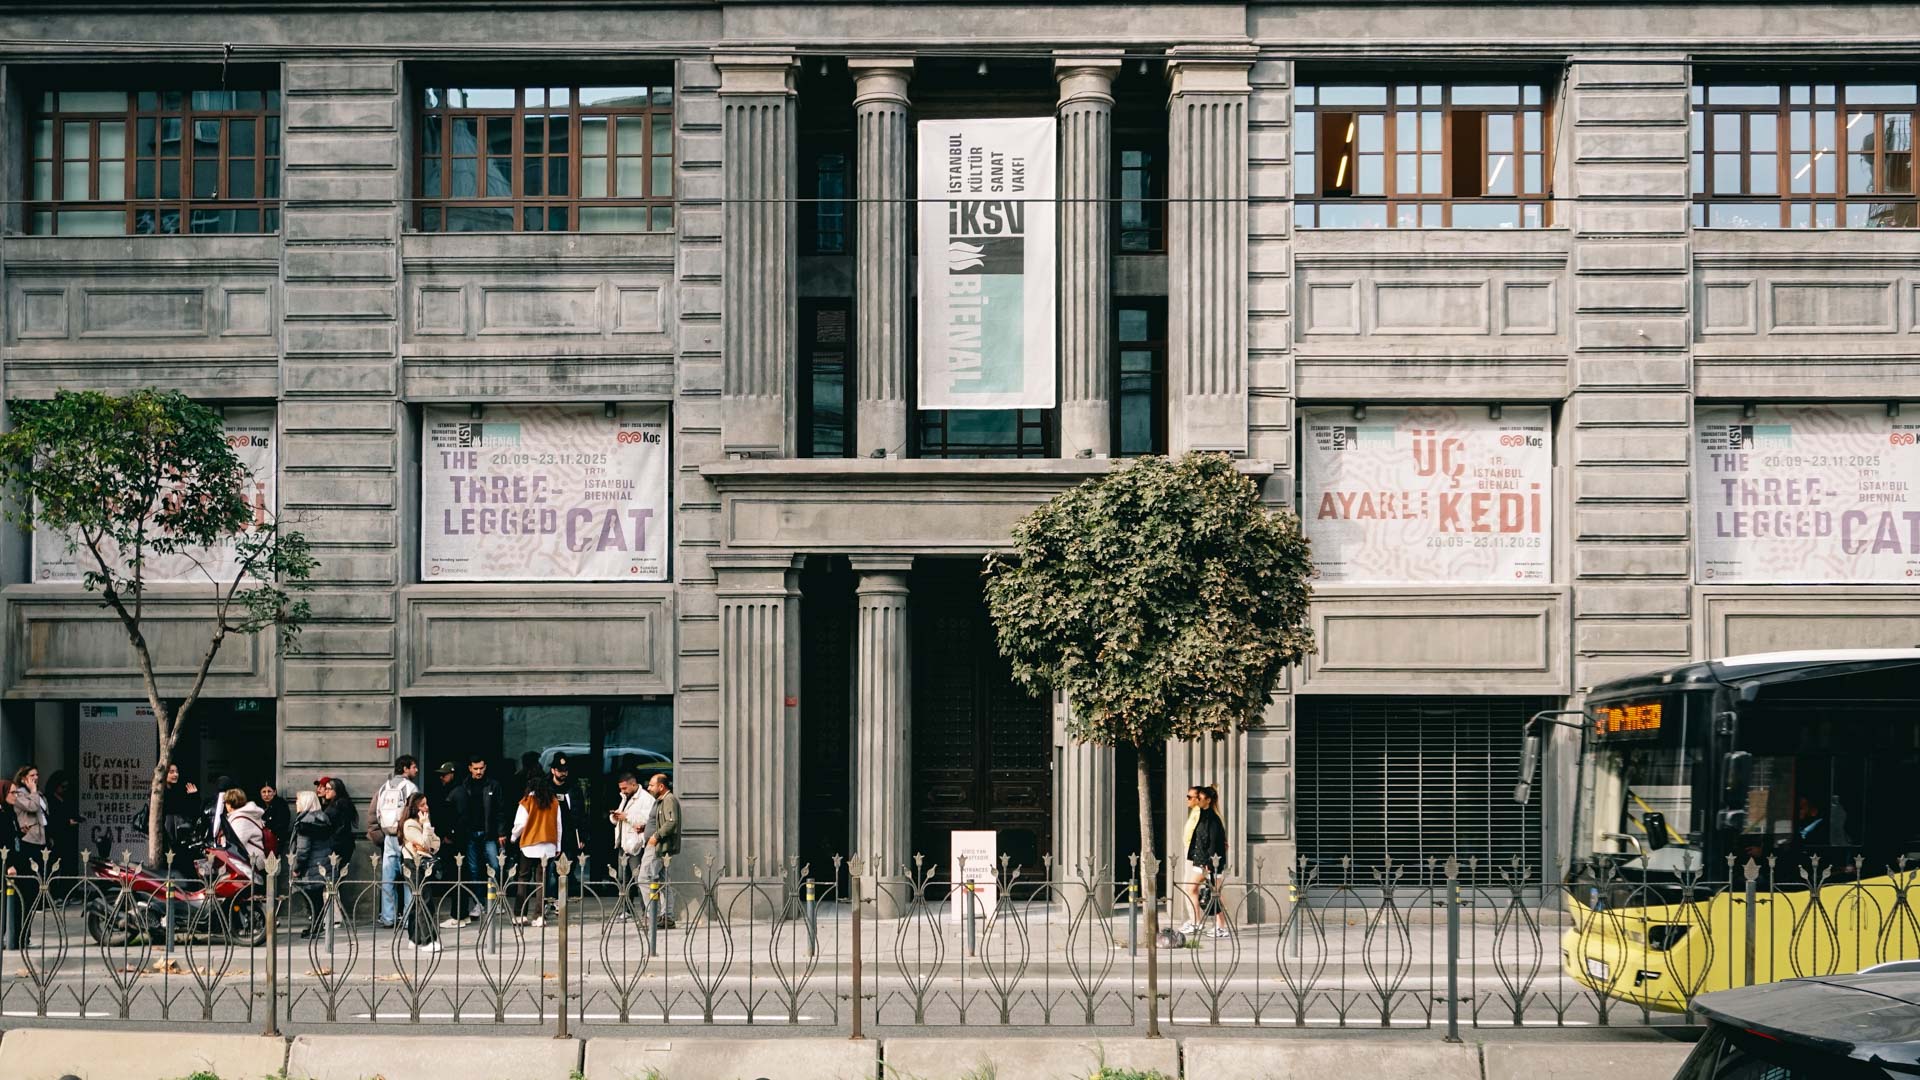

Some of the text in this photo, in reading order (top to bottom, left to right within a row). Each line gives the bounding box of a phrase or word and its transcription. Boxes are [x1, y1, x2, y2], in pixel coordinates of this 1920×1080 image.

[947, 133, 962, 193] İSTANBUL
[967, 146, 983, 193] KÜLTÜR
[991, 152, 1004, 192] SANAT
[1012, 157, 1025, 192] VAKFI
[251, 436, 269, 448] Koç
[643, 432, 661, 445] Koç
[1525, 435, 1543, 449] Koç
[440, 451, 478, 470] THE
[1412, 429, 1466, 489] ÜÇ
[1710, 453, 1749, 472] THE
[450, 475, 563, 504] THREE-
[584, 491, 633, 501] BIENNIAL
[1721, 477, 1837, 506] THREE-
[1859, 493, 1907, 503] BIENNIAL
[1317, 491, 1429, 520] AYAKLI
[1438, 483, 1542, 533] KEDİ
[444, 508, 557, 535] LEGGED
[566, 508, 654, 552] CAT
[1716, 510, 1832, 538] LEGGED
[103, 757, 140, 769] AYAKLI
[89, 770, 129, 790] KEDİ
[100, 814, 133, 824] LEGGE
